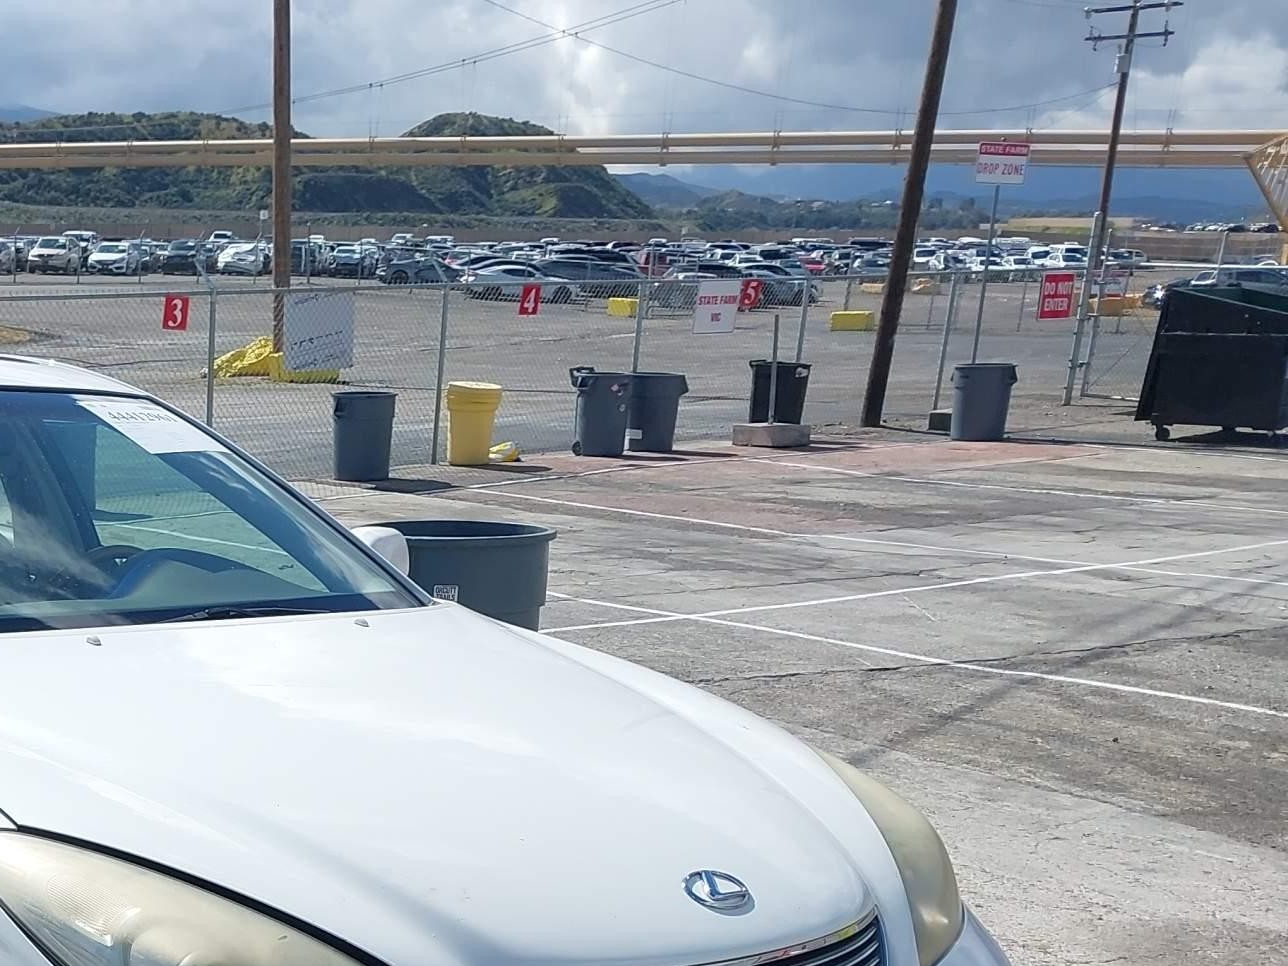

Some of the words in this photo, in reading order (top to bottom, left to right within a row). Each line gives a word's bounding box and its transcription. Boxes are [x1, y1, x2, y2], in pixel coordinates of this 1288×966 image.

[976, 162, 1000, 175] DROP
[1001, 163, 1025, 176] ZONE
[743, 281, 758, 304] 5
[1044, 282, 1056, 295] DO
[1057, 282, 1073, 295] NOT
[523, 288, 537, 313] 4
[698, 295, 720, 305] STATE
[720, 295, 739, 304] FARM
[1044, 298, 1069, 311] ENTER
[168, 299, 183, 327] 3
